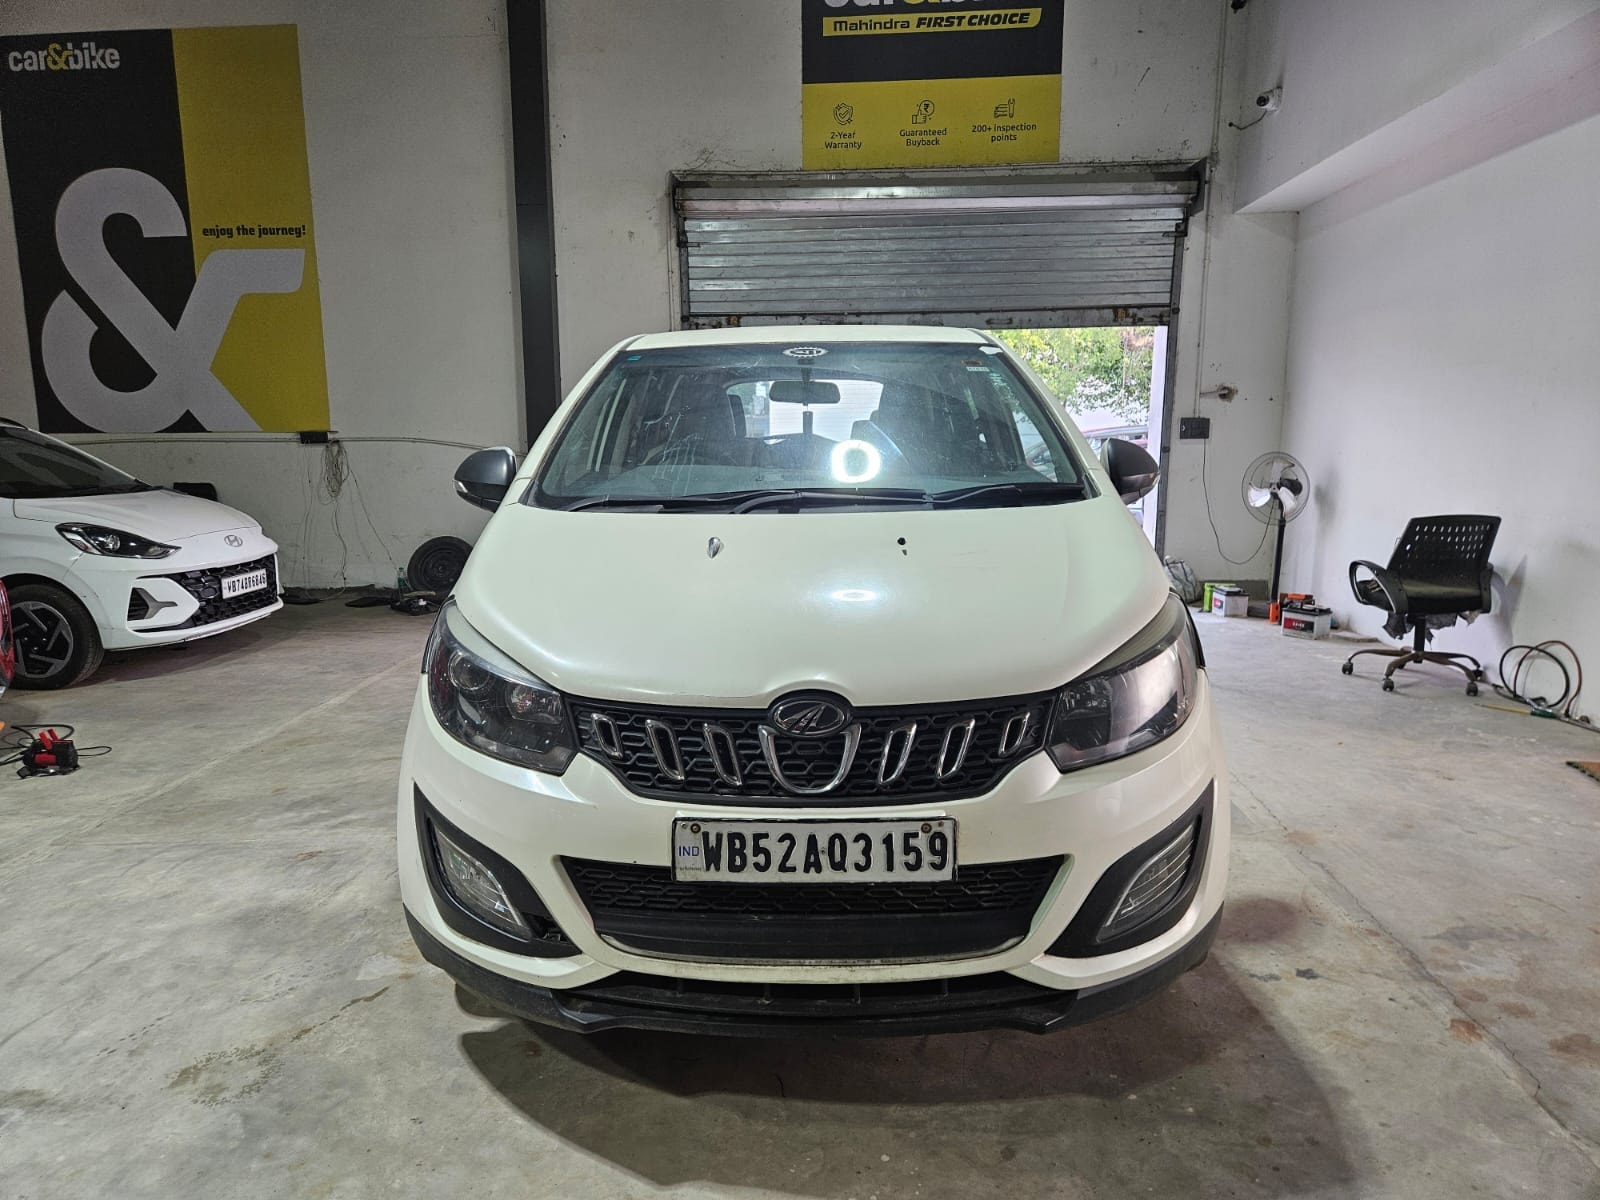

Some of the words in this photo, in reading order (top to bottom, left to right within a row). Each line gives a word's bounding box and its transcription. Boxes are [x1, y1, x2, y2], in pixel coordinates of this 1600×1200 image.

[833, 19, 910, 32] Mahindra
[916, 15, 965, 29] FIRST
[967, 12, 1030, 26] CHOICE
[8, 42, 120, 72] car&bike
[899, 128, 947, 137] Guaranteed
[971, 125, 992, 133] 200+
[830, 131, 856, 139] 2-Year
[991, 134, 1017, 143] points
[825, 141, 862, 150] Warranty
[906, 138, 940, 147] Buyback
[202, 224, 233, 238] enjoy
[236, 224, 255, 236] the
[258, 224, 306, 238] journey!
[678, 846, 699, 857] IND
[702, 831, 948, 873] WB52AQ3159
